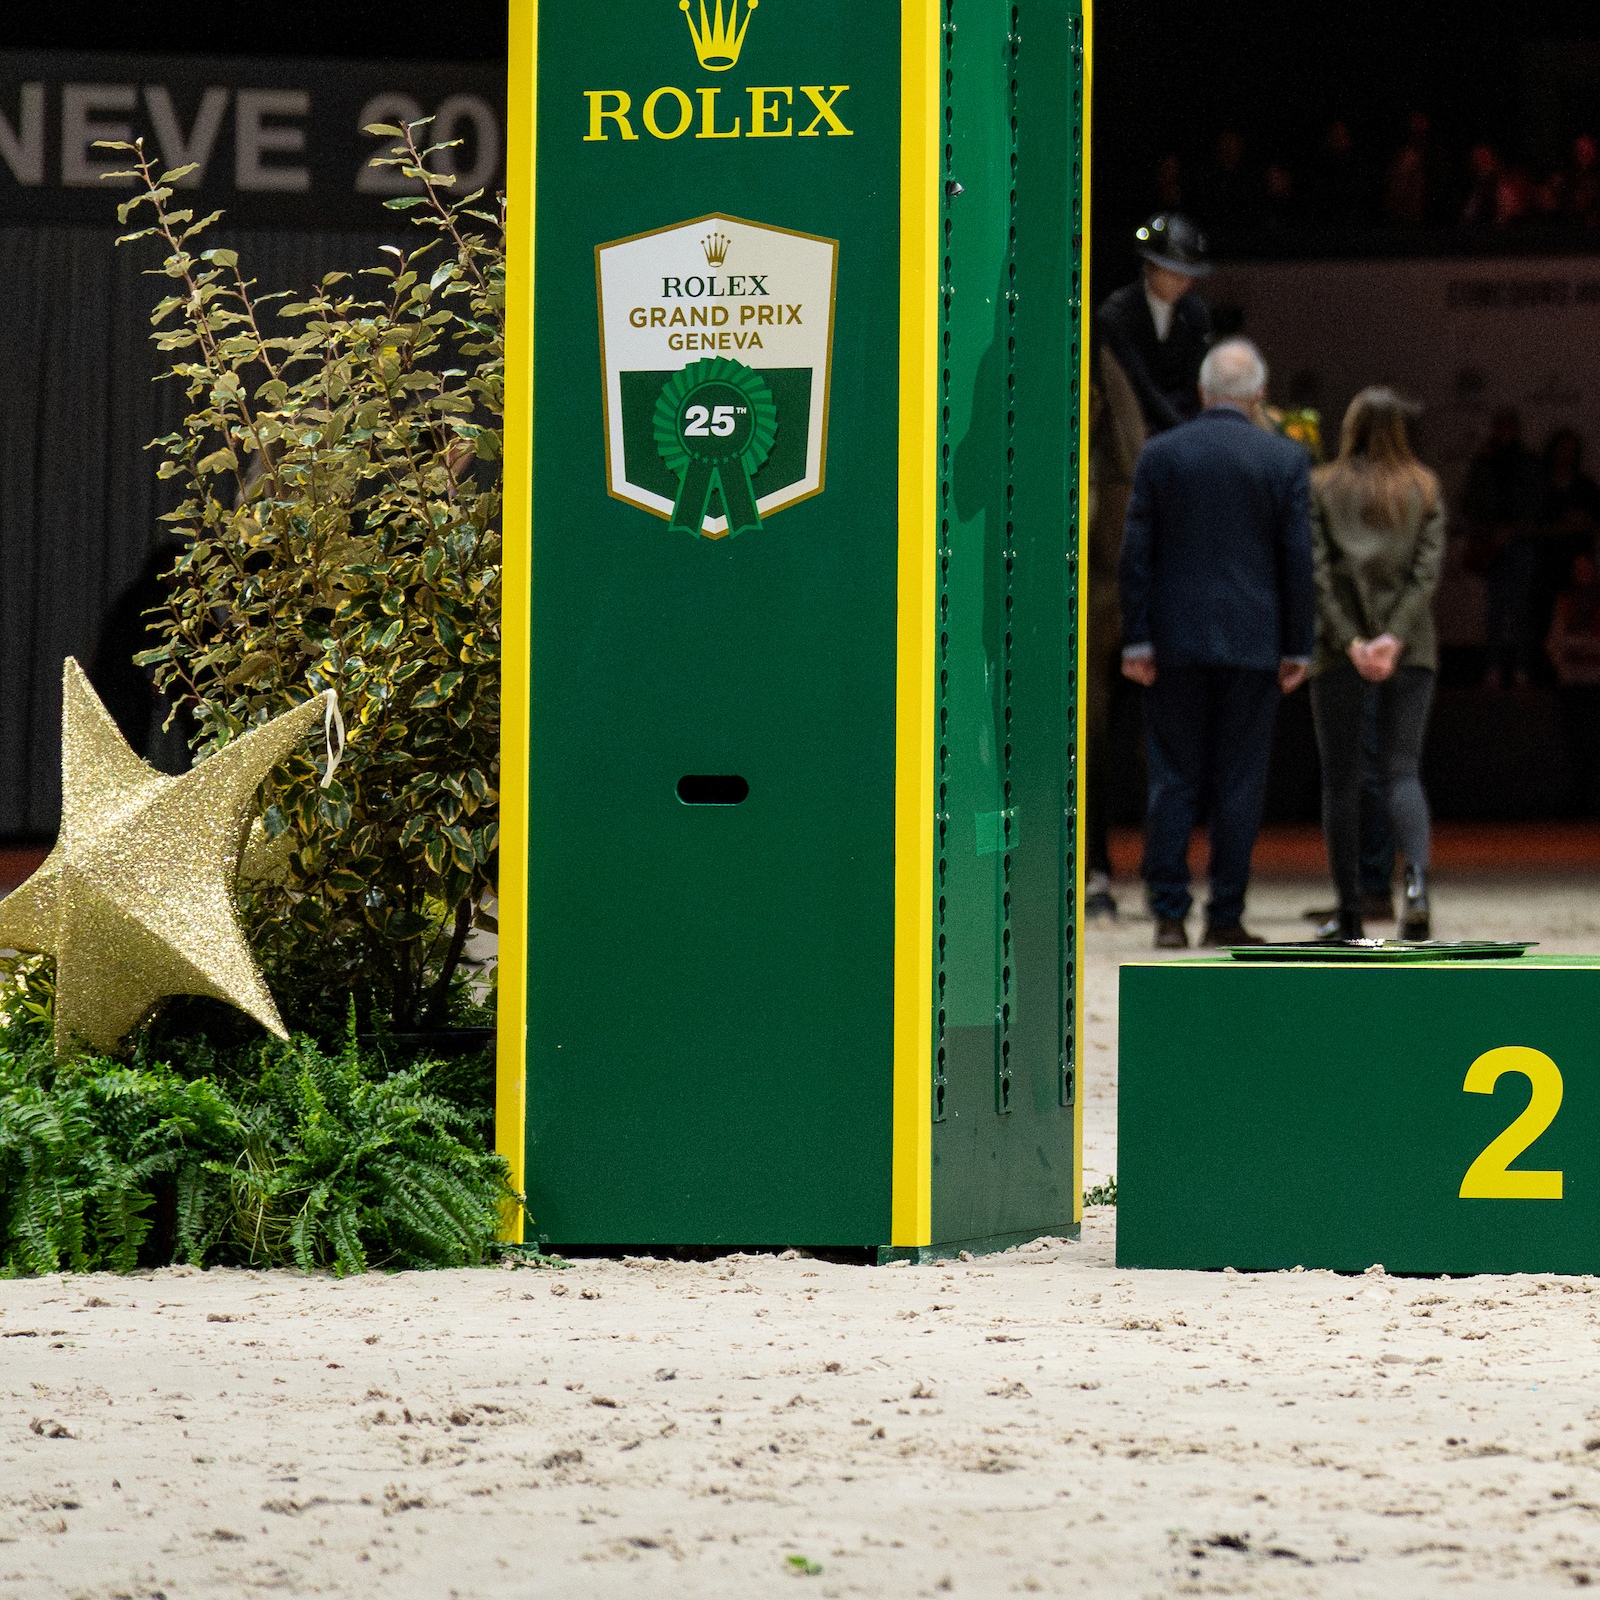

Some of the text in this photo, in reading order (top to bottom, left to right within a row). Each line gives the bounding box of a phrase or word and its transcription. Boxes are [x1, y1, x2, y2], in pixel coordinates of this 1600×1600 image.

[583, 85, 853, 141] ROLEX
[661, 275, 770, 297] ROLEX
[629, 304, 803, 328] GRAND PRIX
[668, 332, 763, 350] GENEVA
[1459, 1045, 1564, 1200] 2
